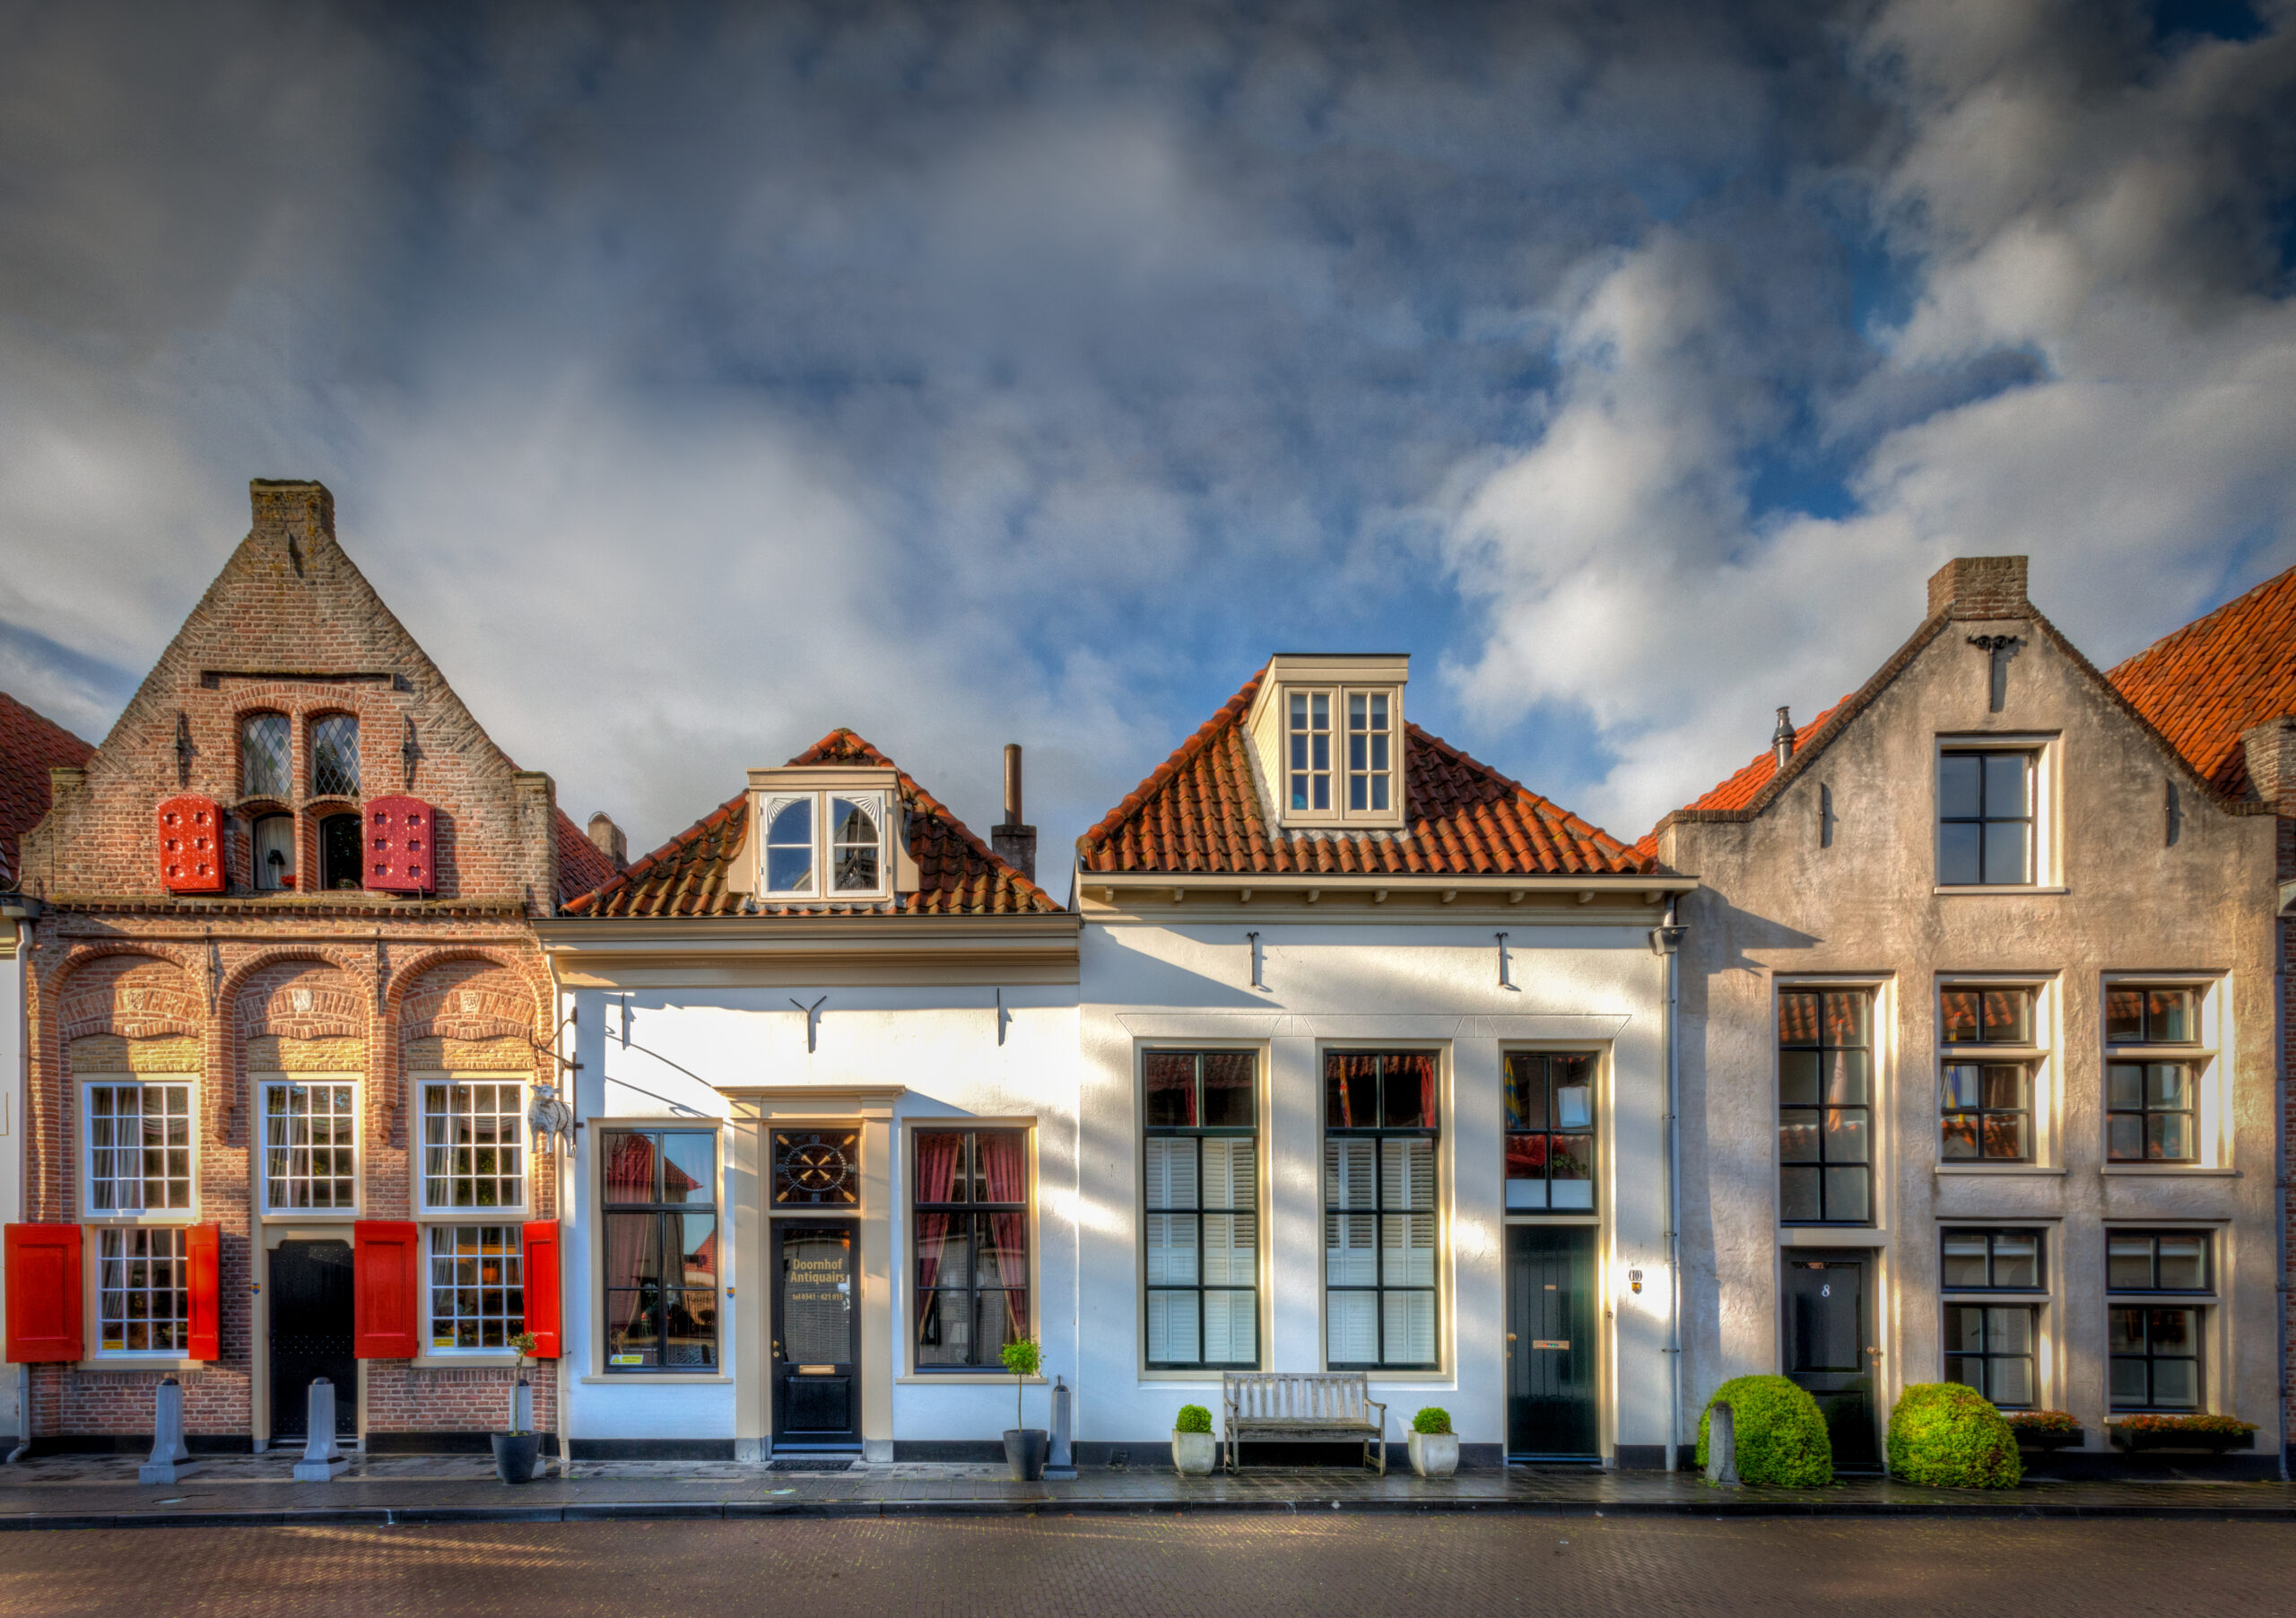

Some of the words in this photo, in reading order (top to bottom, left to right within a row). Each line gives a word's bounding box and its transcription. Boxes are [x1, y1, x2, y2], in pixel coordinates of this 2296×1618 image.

[793, 1258, 843, 1270] Doornhof
[790, 1271, 845, 1285] Antiquairs
[1822, 1284, 1830, 1297] 8
